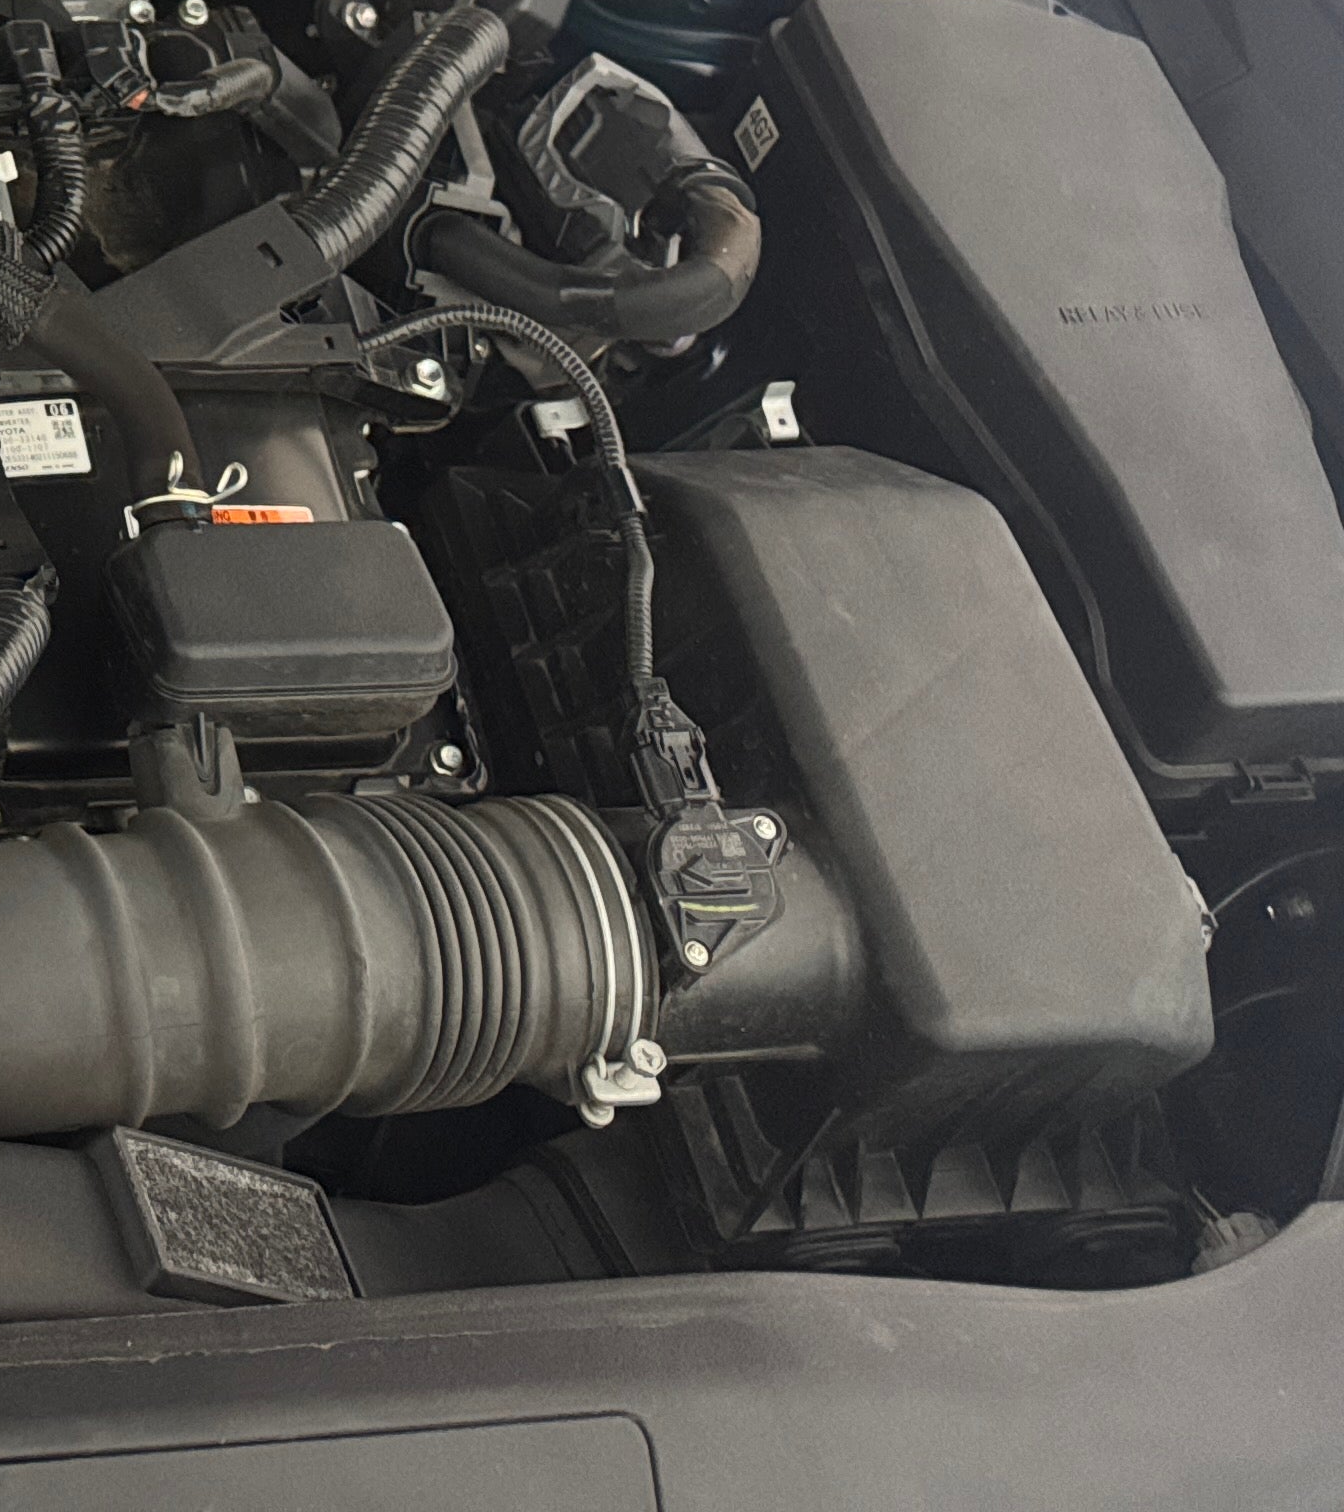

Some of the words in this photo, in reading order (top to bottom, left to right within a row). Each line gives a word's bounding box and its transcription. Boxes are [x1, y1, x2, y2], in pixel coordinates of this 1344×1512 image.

[748, 108, 774, 146] 4G7
[49, 403, 69, 416] 06
[0, 428, 27, 436] YOTA
